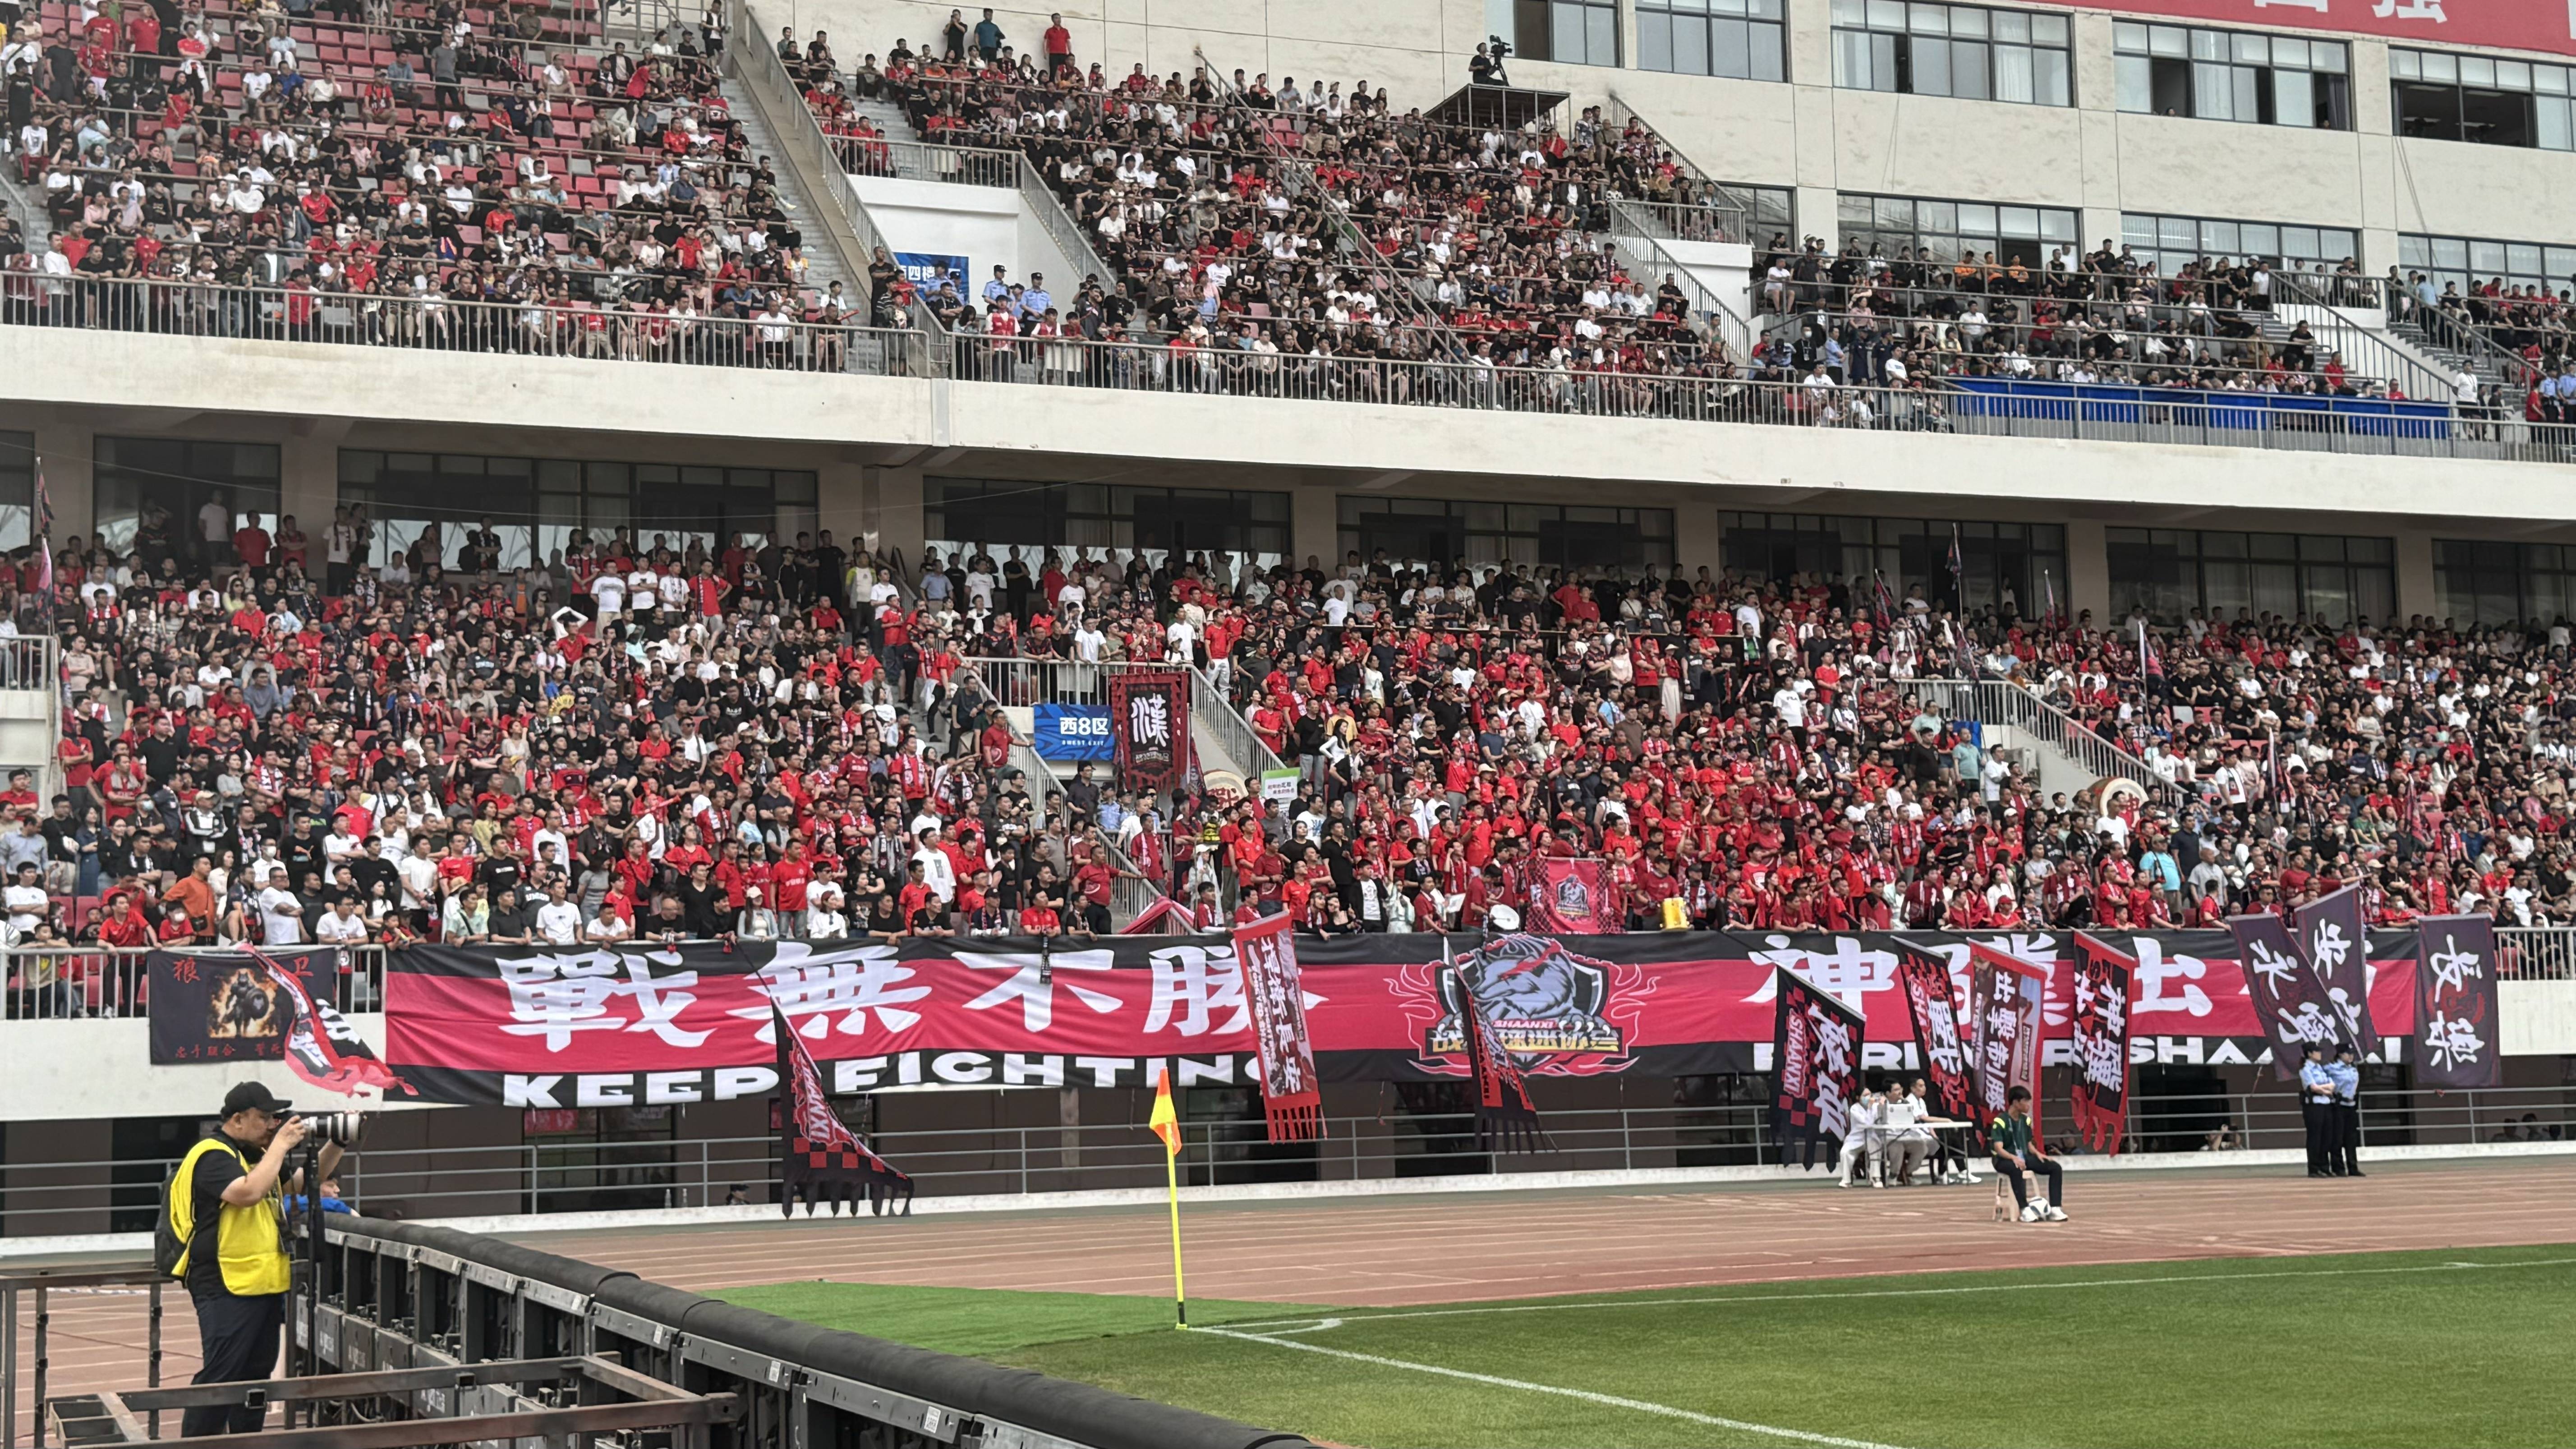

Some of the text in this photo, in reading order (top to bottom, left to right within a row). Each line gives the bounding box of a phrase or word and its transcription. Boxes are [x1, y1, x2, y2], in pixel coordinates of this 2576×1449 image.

[1060, 717, 1109, 735] 西8区
[495, 941, 1329, 1053] 戰無不勝
[1785, 1015, 1805, 1095] SHAANXI
[1985, 971, 2018, 1113] 出擊制勝
[503, 1066, 779, 1109] KEEP
